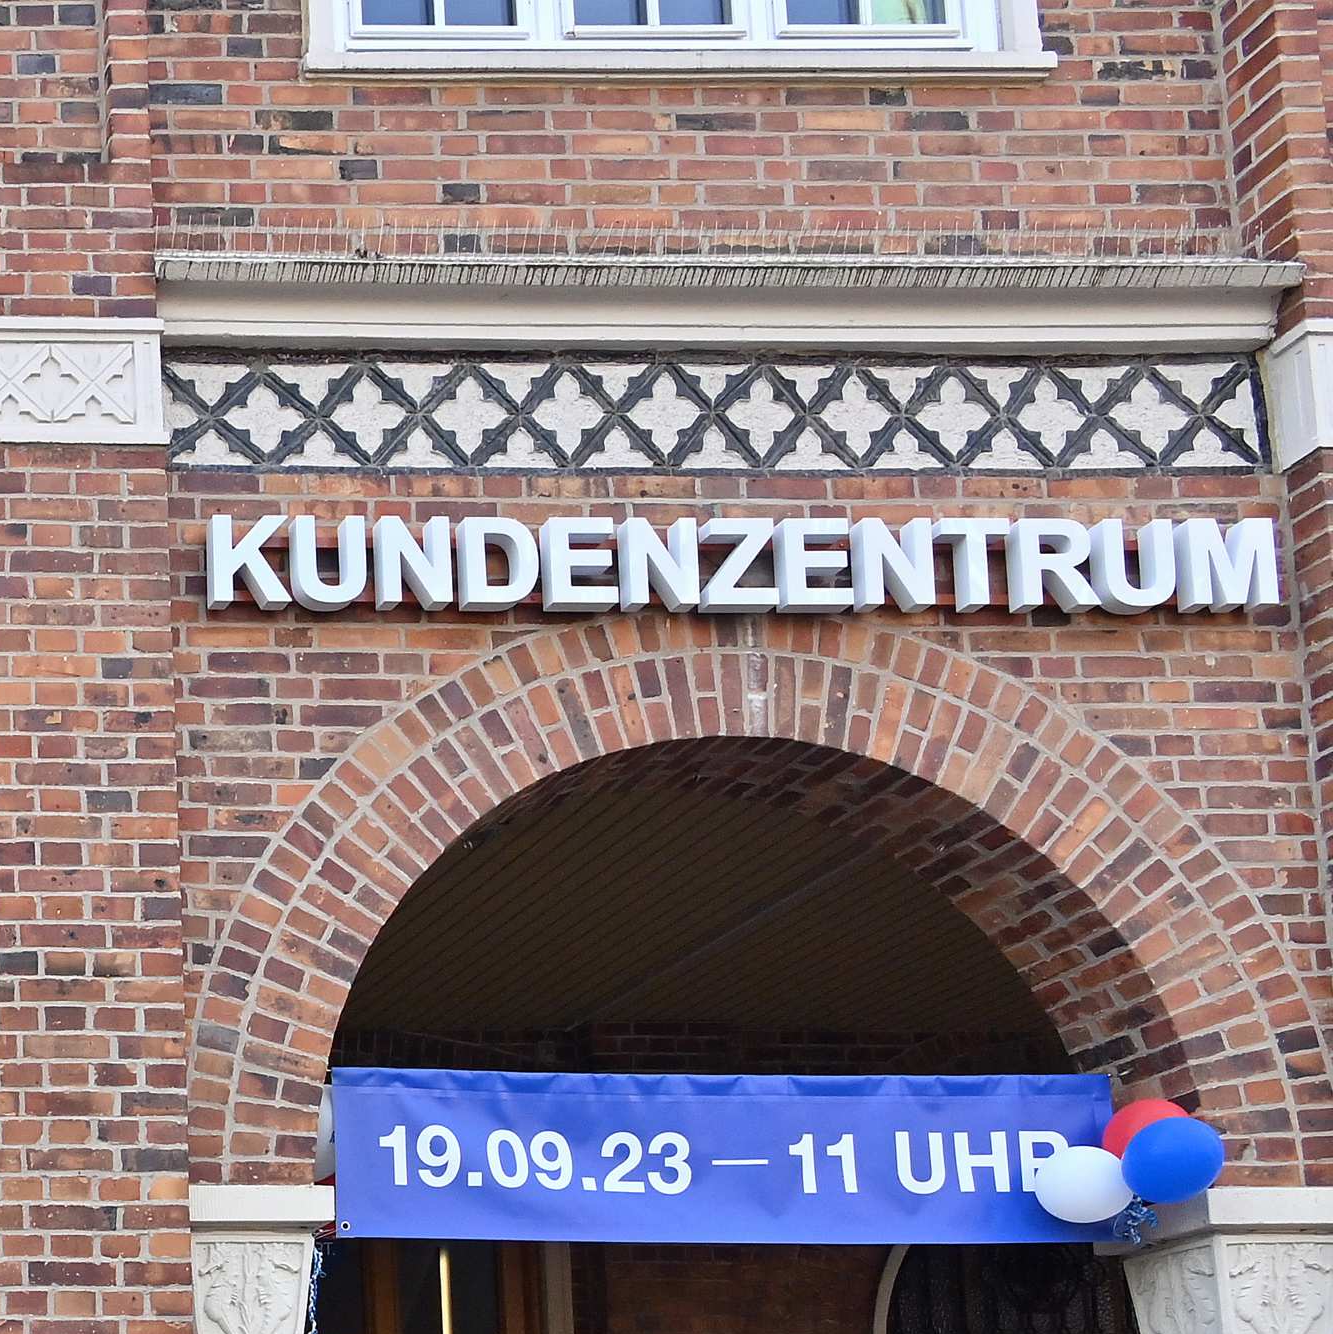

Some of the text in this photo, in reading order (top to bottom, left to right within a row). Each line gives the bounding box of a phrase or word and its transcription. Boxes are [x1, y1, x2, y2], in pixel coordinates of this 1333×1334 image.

[205, 514, 1280, 614] KUNDENZENTRUM
[378, 1123, 693, 1196] 19.09.23
[788, 1132, 860, 1195] 11
